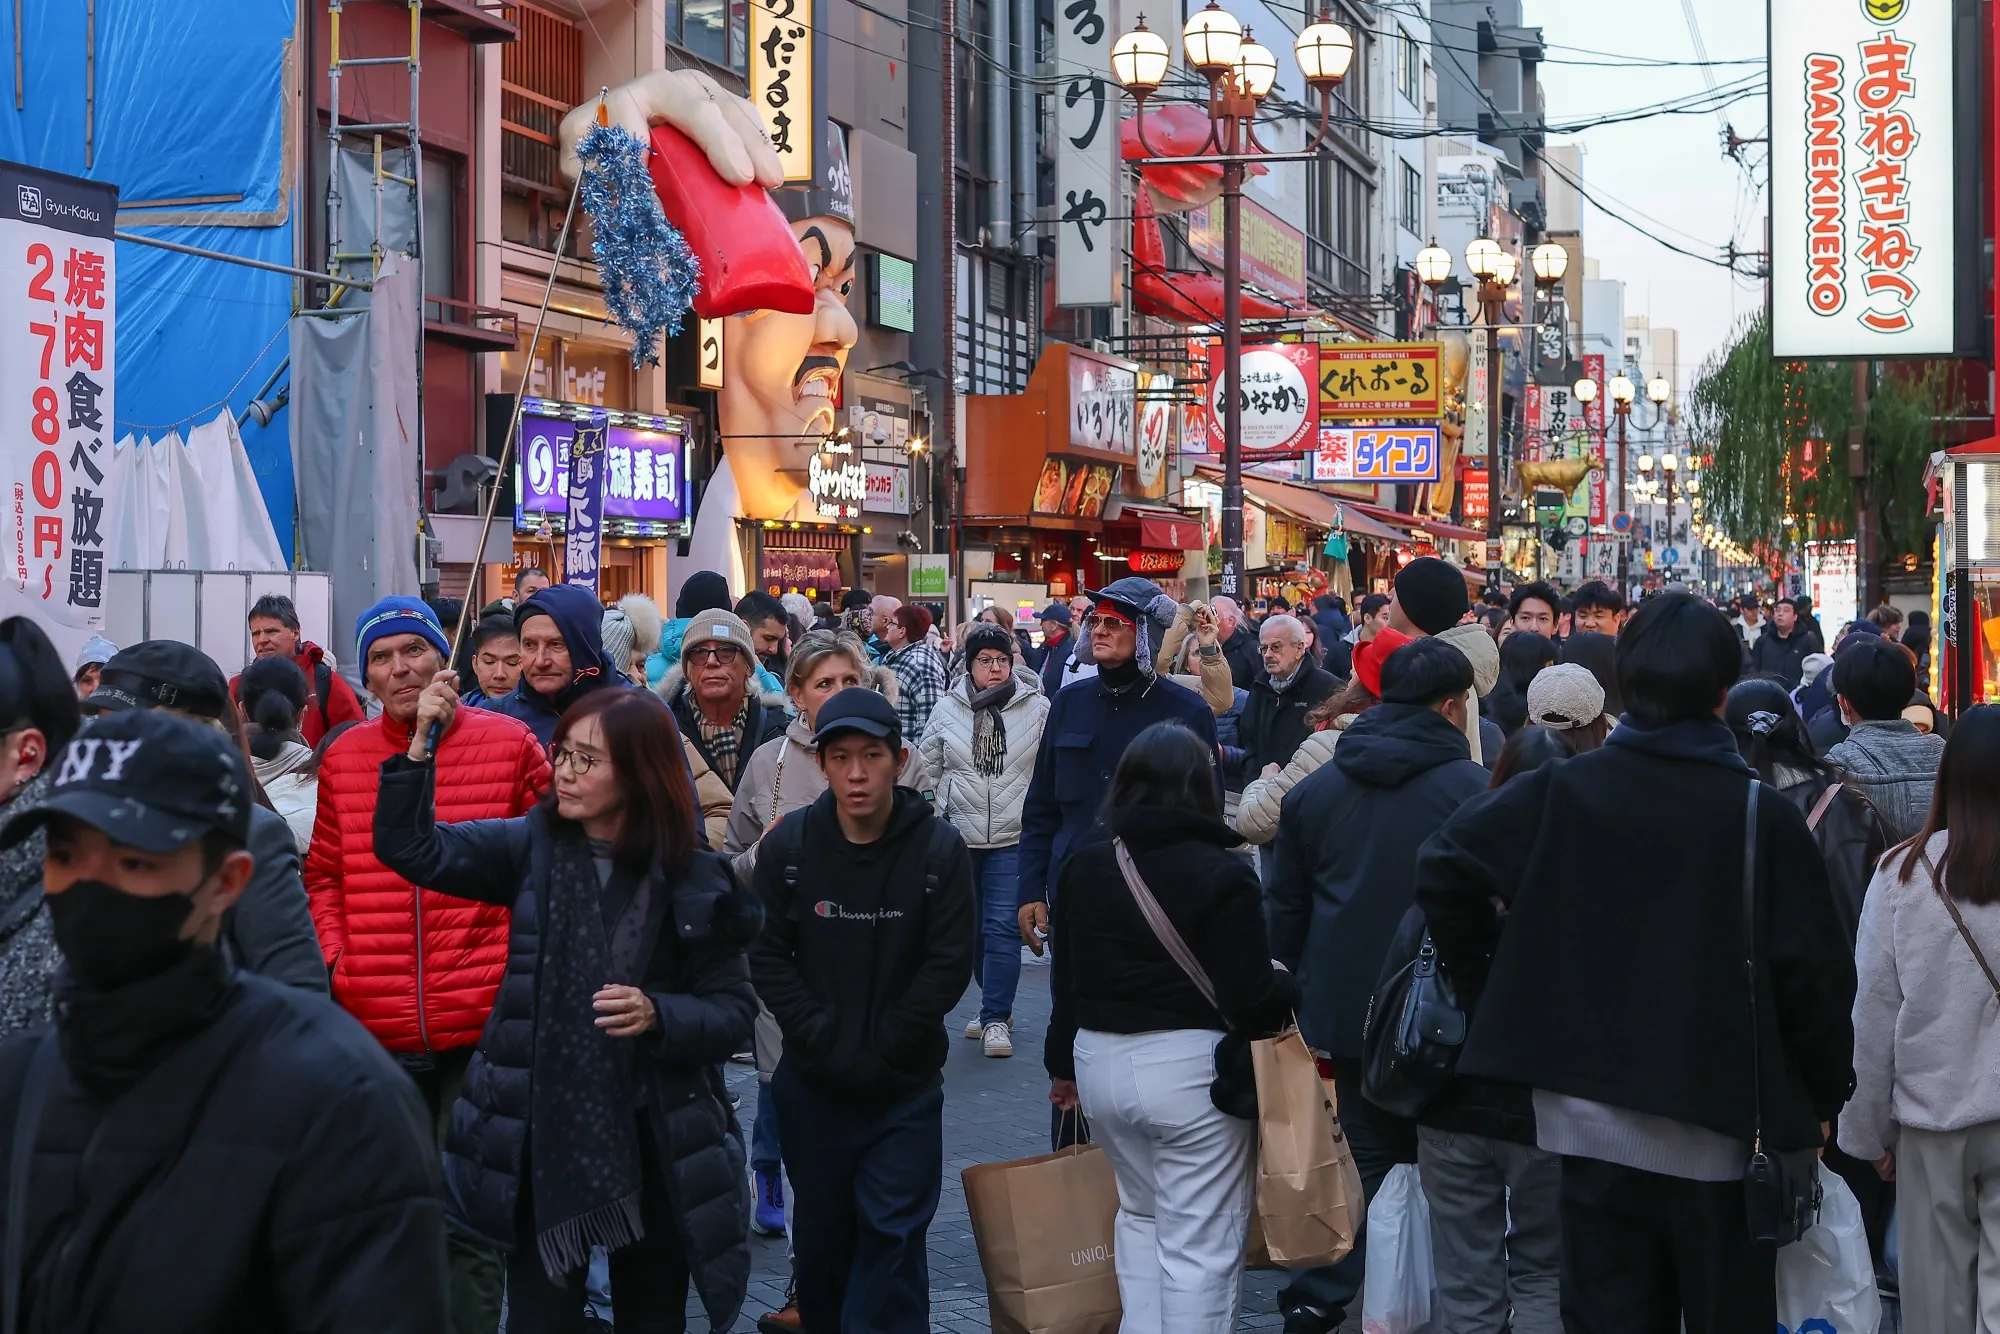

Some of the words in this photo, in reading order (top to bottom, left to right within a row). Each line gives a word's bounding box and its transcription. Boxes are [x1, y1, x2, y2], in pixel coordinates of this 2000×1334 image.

[1062, 0, 1106, 252] ろりや
[1808, 56, 1843, 314] MANEKINEKO
[1856, 33, 1918, 331] まねきねこ
[45, 198, 100, 222] Gyu-Kaku
[703, 318, 719, 370] つ
[63, 247, 106, 607] 焼肉食べ放題
[1077, 398, 1129, 452] いろりや
[1287, 420, 1312, 449] WANAKA
[1319, 430, 1348, 463] 薬
[602, 446, 677, 503] 禄寿司
[1317, 467, 1336, 477] 免税
[1357, 435, 1431, 473] ダイコク
[866, 472, 892, 494] ジャンカラ
[55, 739, 142, 787] NY
[815, 901, 903, 926] Champion
[1071, 1244, 1115, 1266] UNIQL
